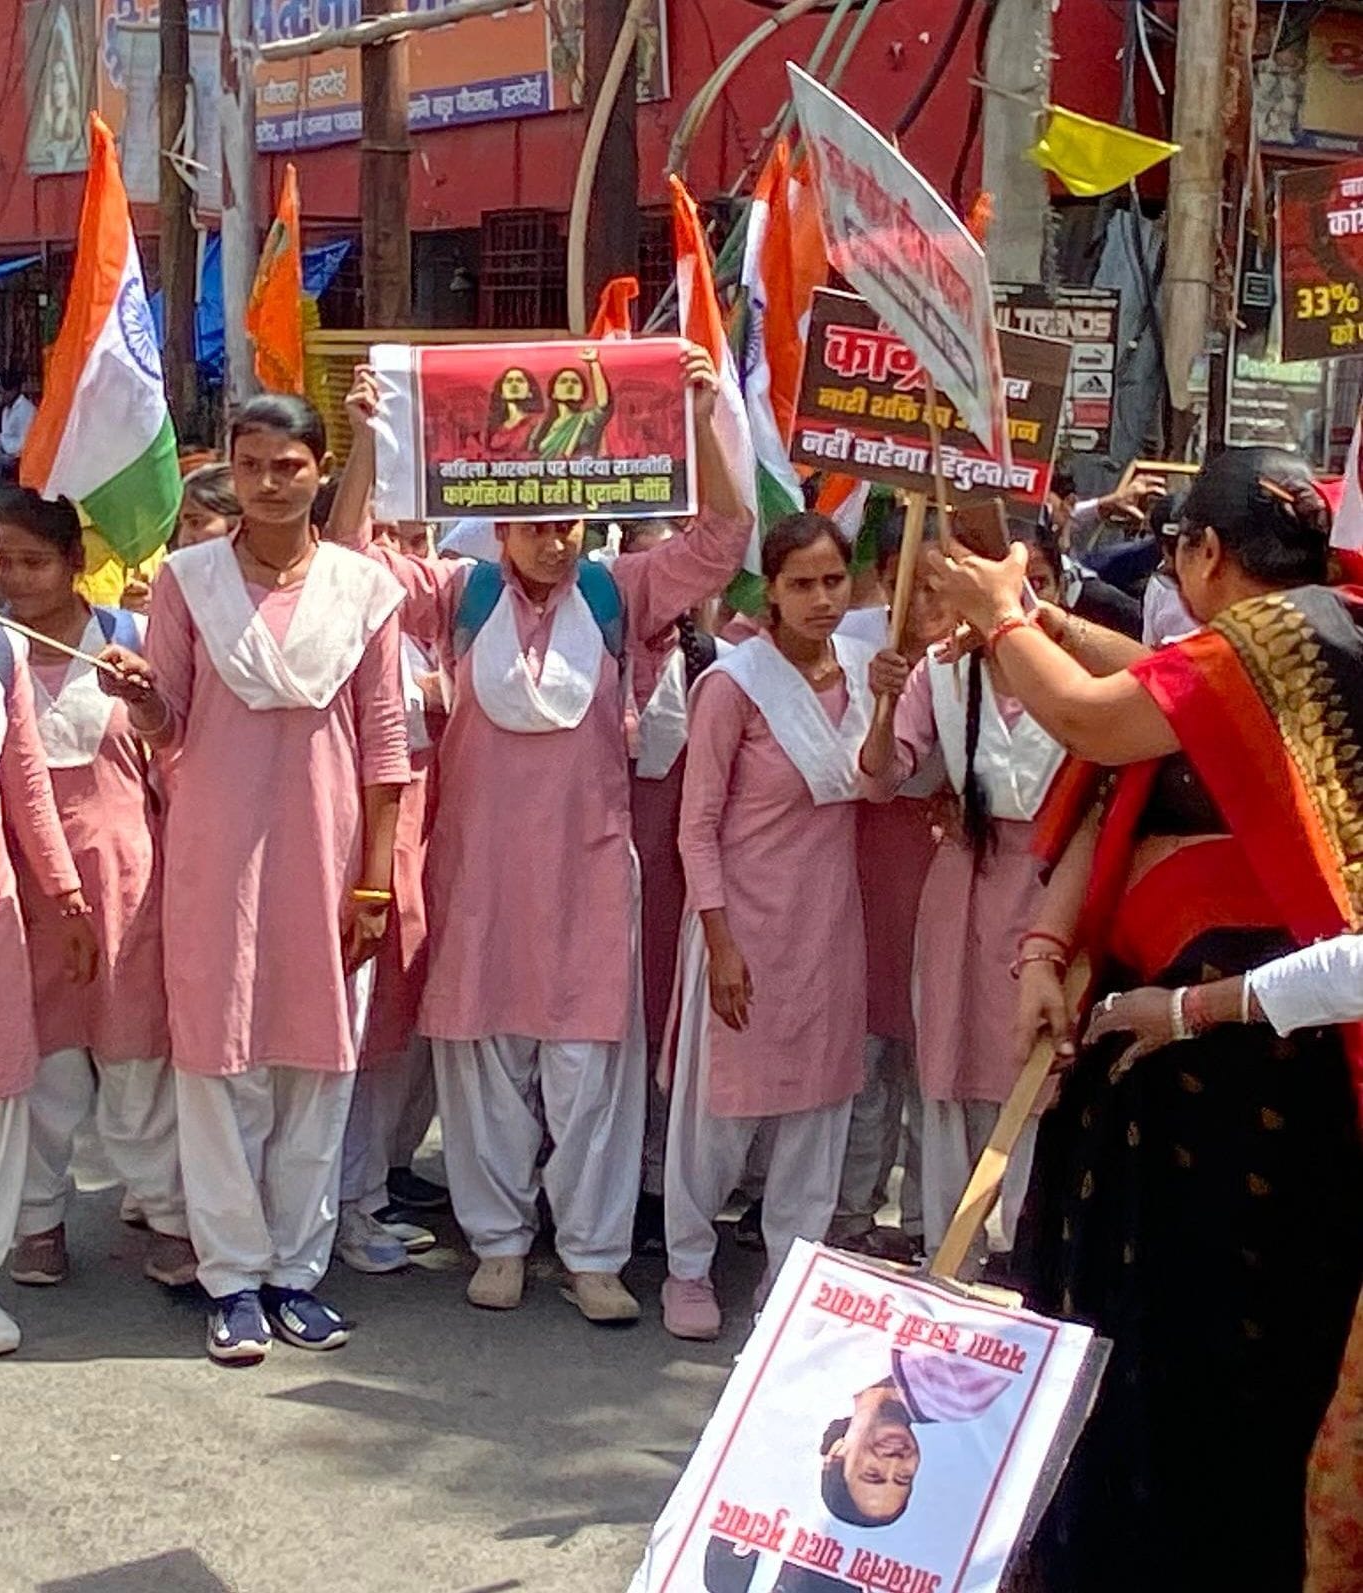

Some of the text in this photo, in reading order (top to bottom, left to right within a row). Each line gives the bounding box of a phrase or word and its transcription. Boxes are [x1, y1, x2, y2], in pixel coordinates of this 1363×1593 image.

[1296, 281, 1360, 319] 33%
[818, 386, 868, 415] नारी
[439, 458, 487, 478] महिला
[490, 459, 544, 478] आरक्षण
[546, 459, 568, 477] पर
[613, 454, 673, 476] राजनीति
[802, 429, 854, 461] नहीं
[854, 437, 929, 473] सहेगा
[518, 478, 540, 505] की
[542, 478, 570, 504] रही
[585, 477, 632, 511] पुरानी
[811, 1281, 898, 1333] मुर्दाबाद
[962, 1331, 1028, 1374] ममता
[708, 1500, 791, 1556] मुर्दाबाद
[788, 1526, 846, 1574] यादव
